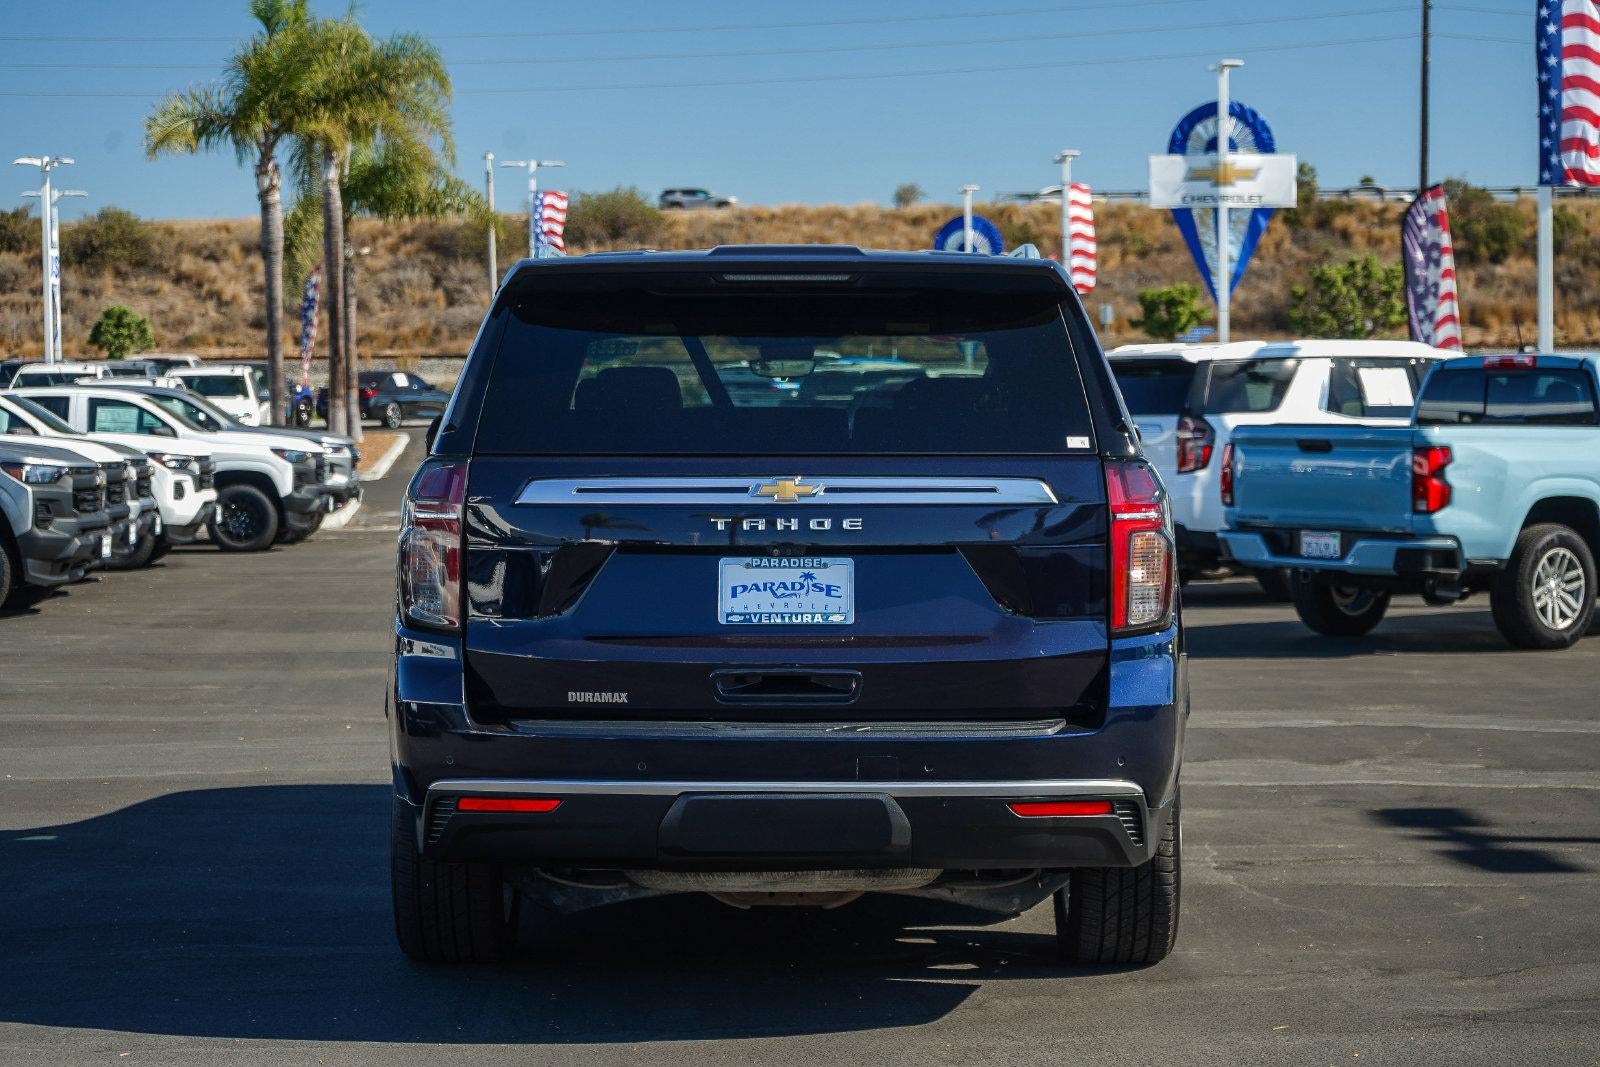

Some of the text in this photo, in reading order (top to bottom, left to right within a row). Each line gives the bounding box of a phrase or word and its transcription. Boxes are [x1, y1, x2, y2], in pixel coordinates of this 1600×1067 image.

[710, 518, 863, 531] TAHOE
[752, 558, 821, 567] PARADISE
[730, 571, 842, 599] PARADISE
[730, 602, 842, 613] CHEVROLET
[750, 613, 823, 623] VENTURA
[567, 691, 628, 703] DURAMAX
